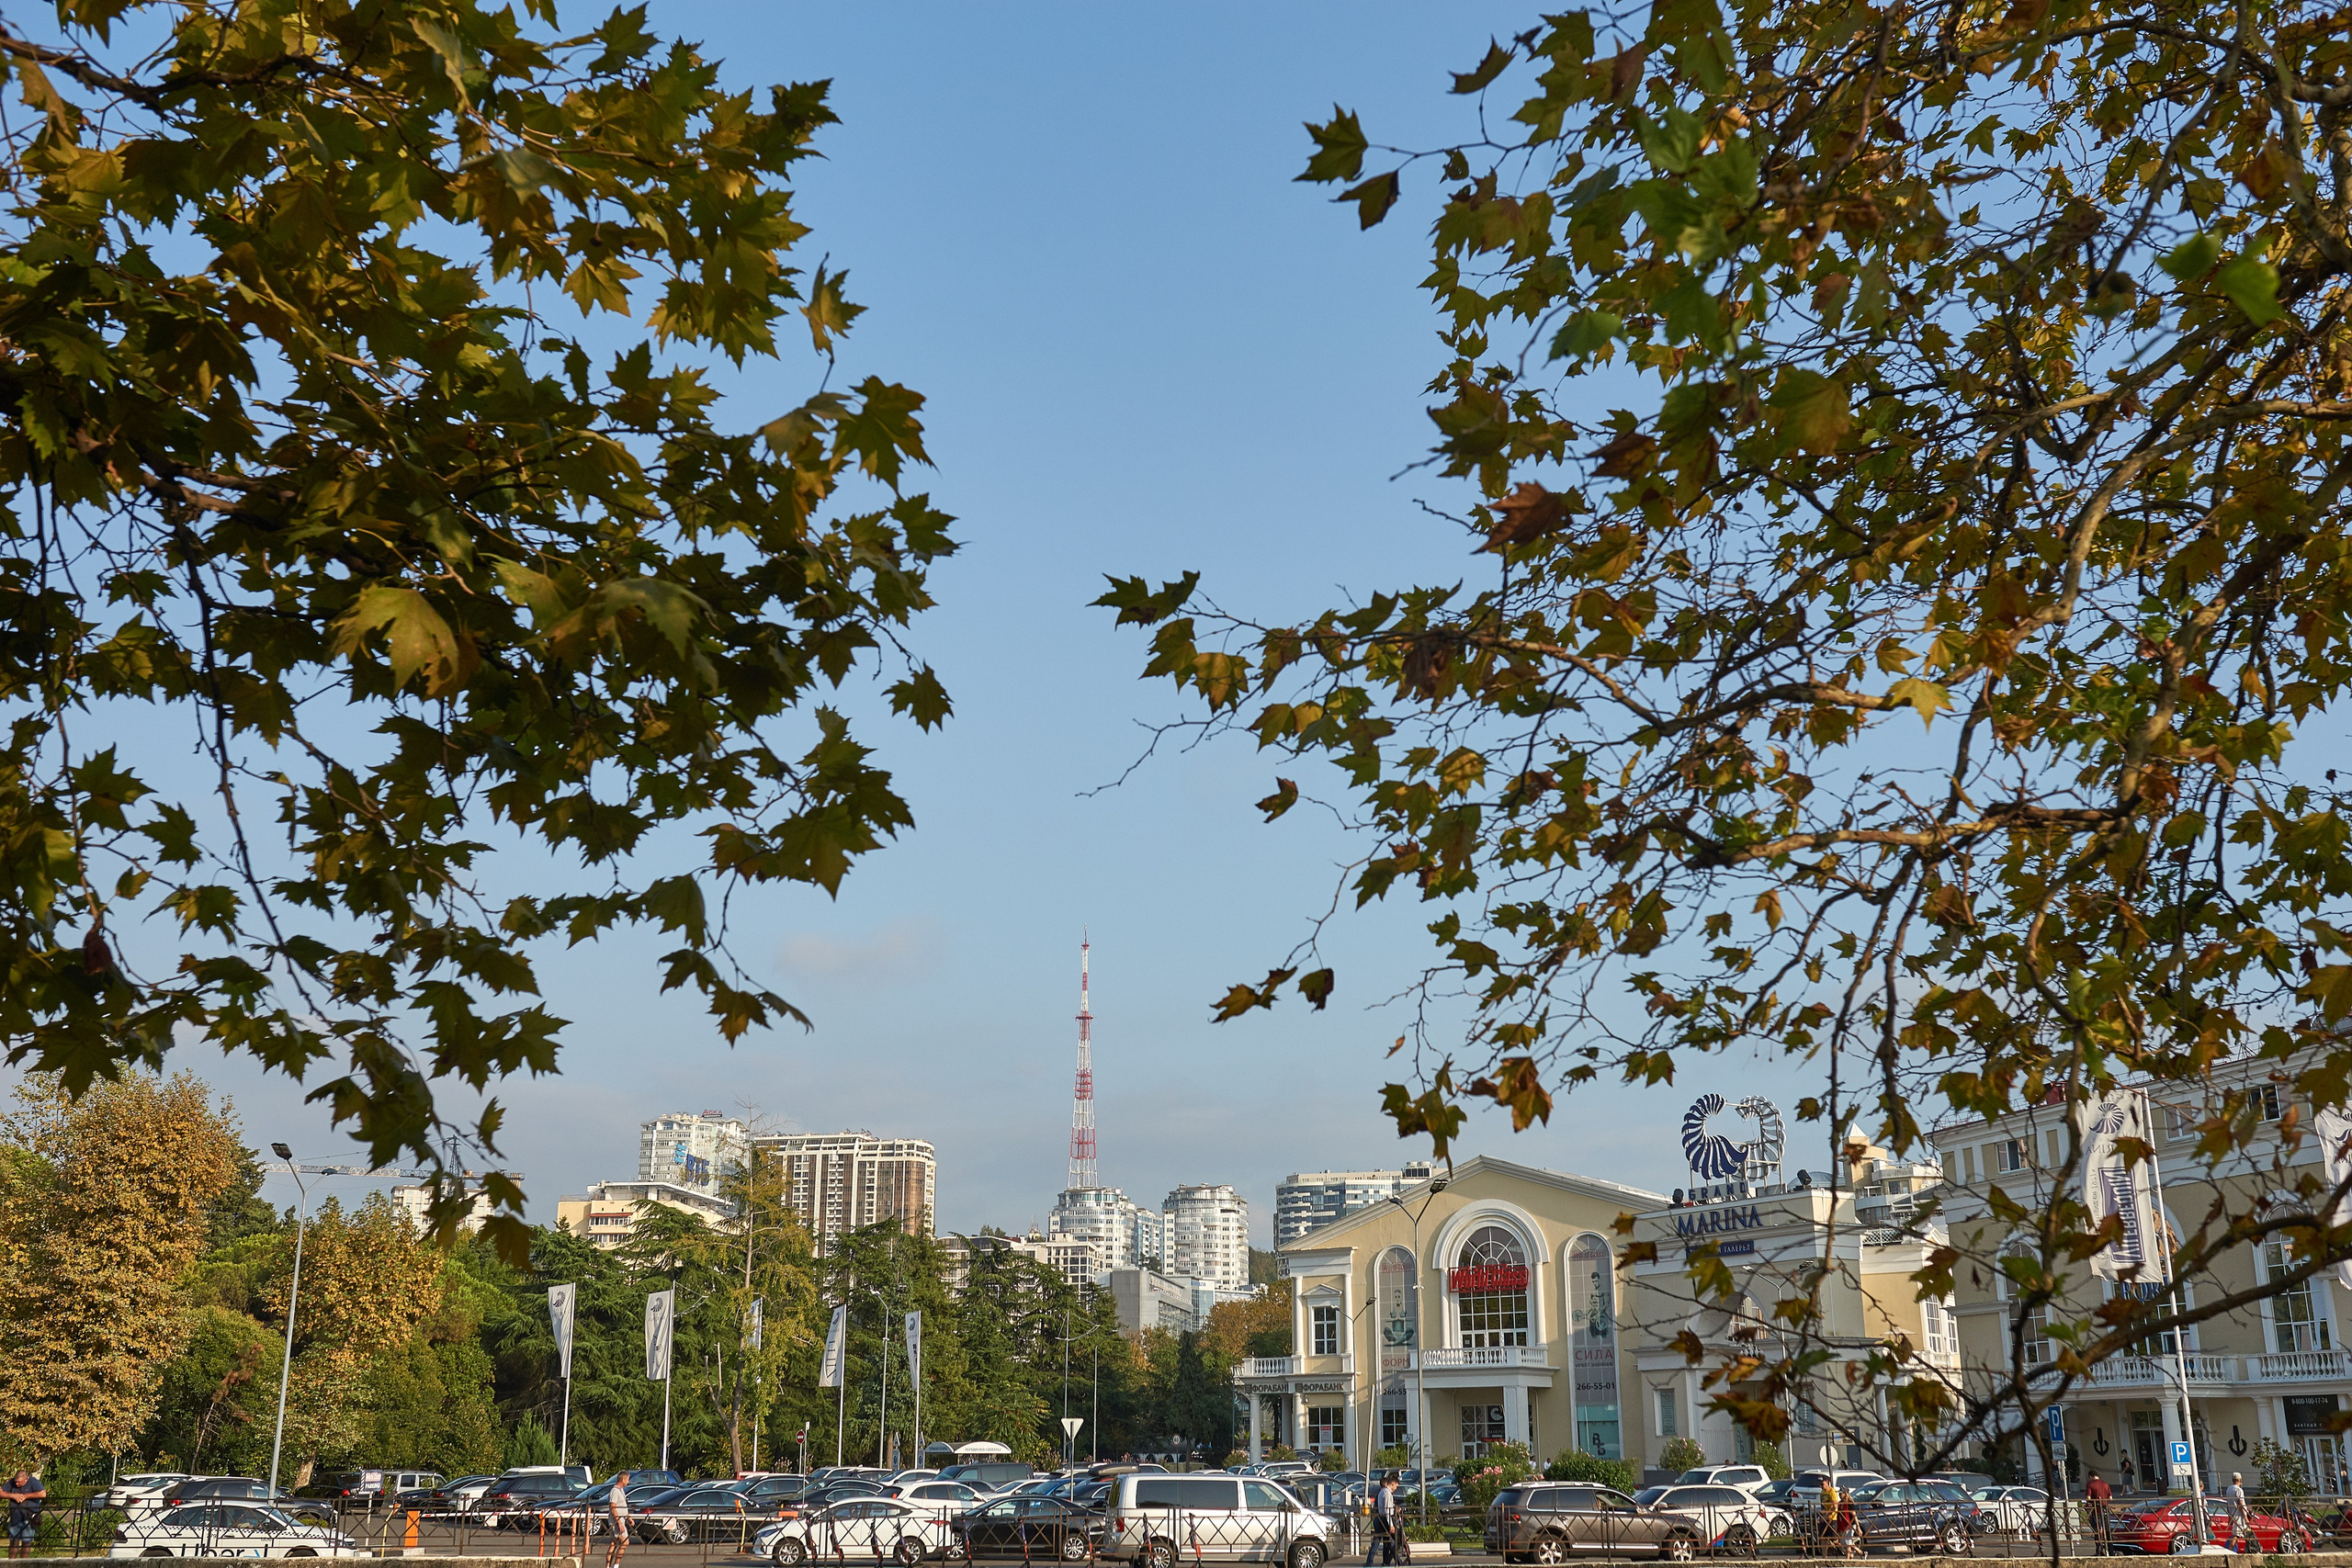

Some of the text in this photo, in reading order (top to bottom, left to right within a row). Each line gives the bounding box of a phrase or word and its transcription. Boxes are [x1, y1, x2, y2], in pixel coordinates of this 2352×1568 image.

[686, 1154, 710, 1186] ВТБ
[1689, 1181, 1747, 1201] GRAND
[1678, 1206, 1763, 1235] MARINA
[1452, 1267, 1526, 1289] World Class
[1383, 1359, 1410, 1367] ФОРМ
[1575, 1349, 1612, 1360] СИЛА
[1252, 1384, 1288, 1393] ФОРАБАН
[1303, 1382, 1344, 1392] ФОРАБАНК
[2052, 1409, 2060, 1438] P
[2176, 1444, 2187, 1461] P
[181, 1543, 245, 1557] Uber
